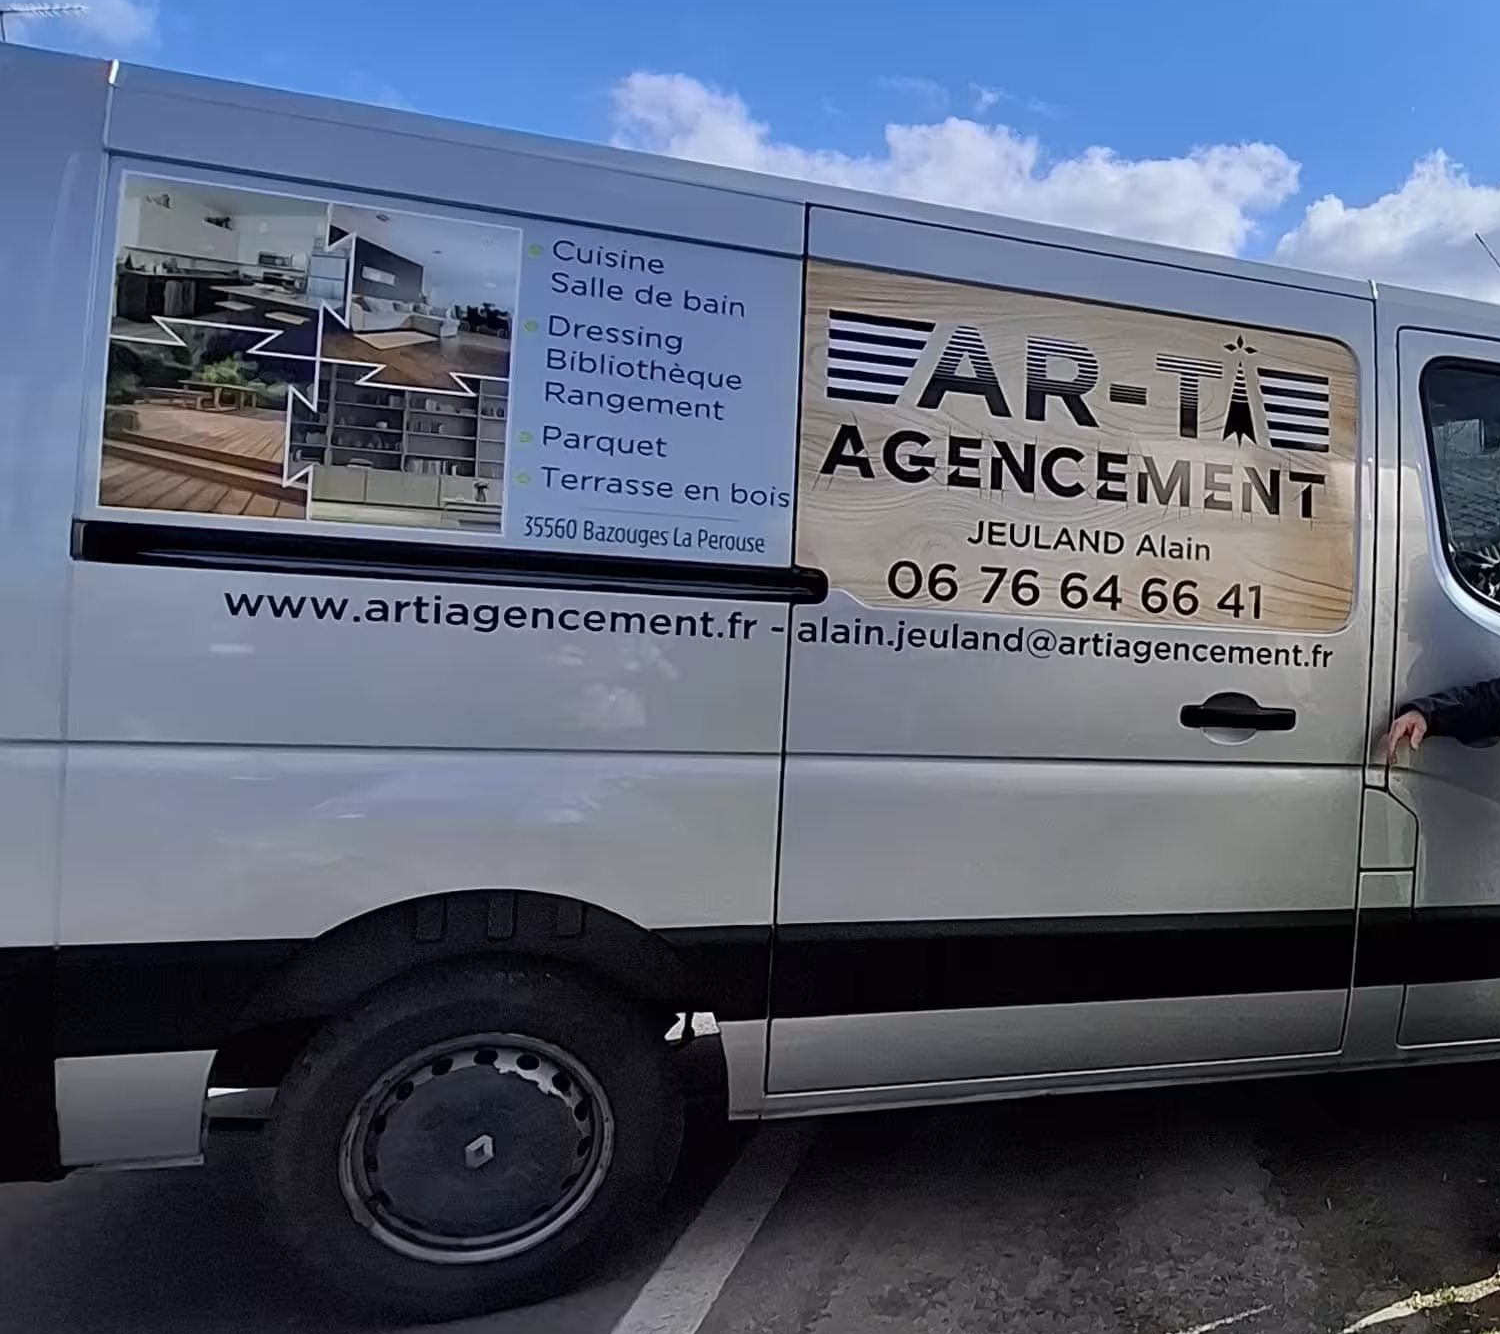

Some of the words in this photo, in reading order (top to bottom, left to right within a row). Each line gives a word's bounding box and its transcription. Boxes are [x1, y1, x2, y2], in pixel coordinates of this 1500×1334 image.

[552, 239, 666, 276] Cuisine
[550, 271, 624, 302] Salle
[634, 279, 675, 309] de
[683, 290, 747, 319] bain
[547, 314, 684, 354] Dressing
[546, 347, 743, 394] Bibliothèque
[544, 380, 726, 422] Rangement
[541, 424, 669, 461] Parquet
[541, 466, 675, 500] Terrasse
[684, 480, 720, 501] en
[730, 475, 791, 509] bois
[818, 423, 1326, 520] AGENCEMENT
[523, 514, 578, 542] 35560
[582, 518, 669, 551] Bazouges
[672, 524, 694, 549] La
[697, 527, 766, 555] Perouse
[967, 520, 1125, 555] JEULAND
[1135, 535, 1211, 563] Alain
[886, 559, 960, 604] 06
[980, 566, 1041, 607] 76
[1059, 572, 1123, 612] 64
[1140, 578, 1200, 617] 66
[1216, 584, 1263, 620] 41
[223, 589, 758, 643] www.artiagencement.fr
[796, 616, 1334, 670] alain.jeuland@artiagencement.fr
